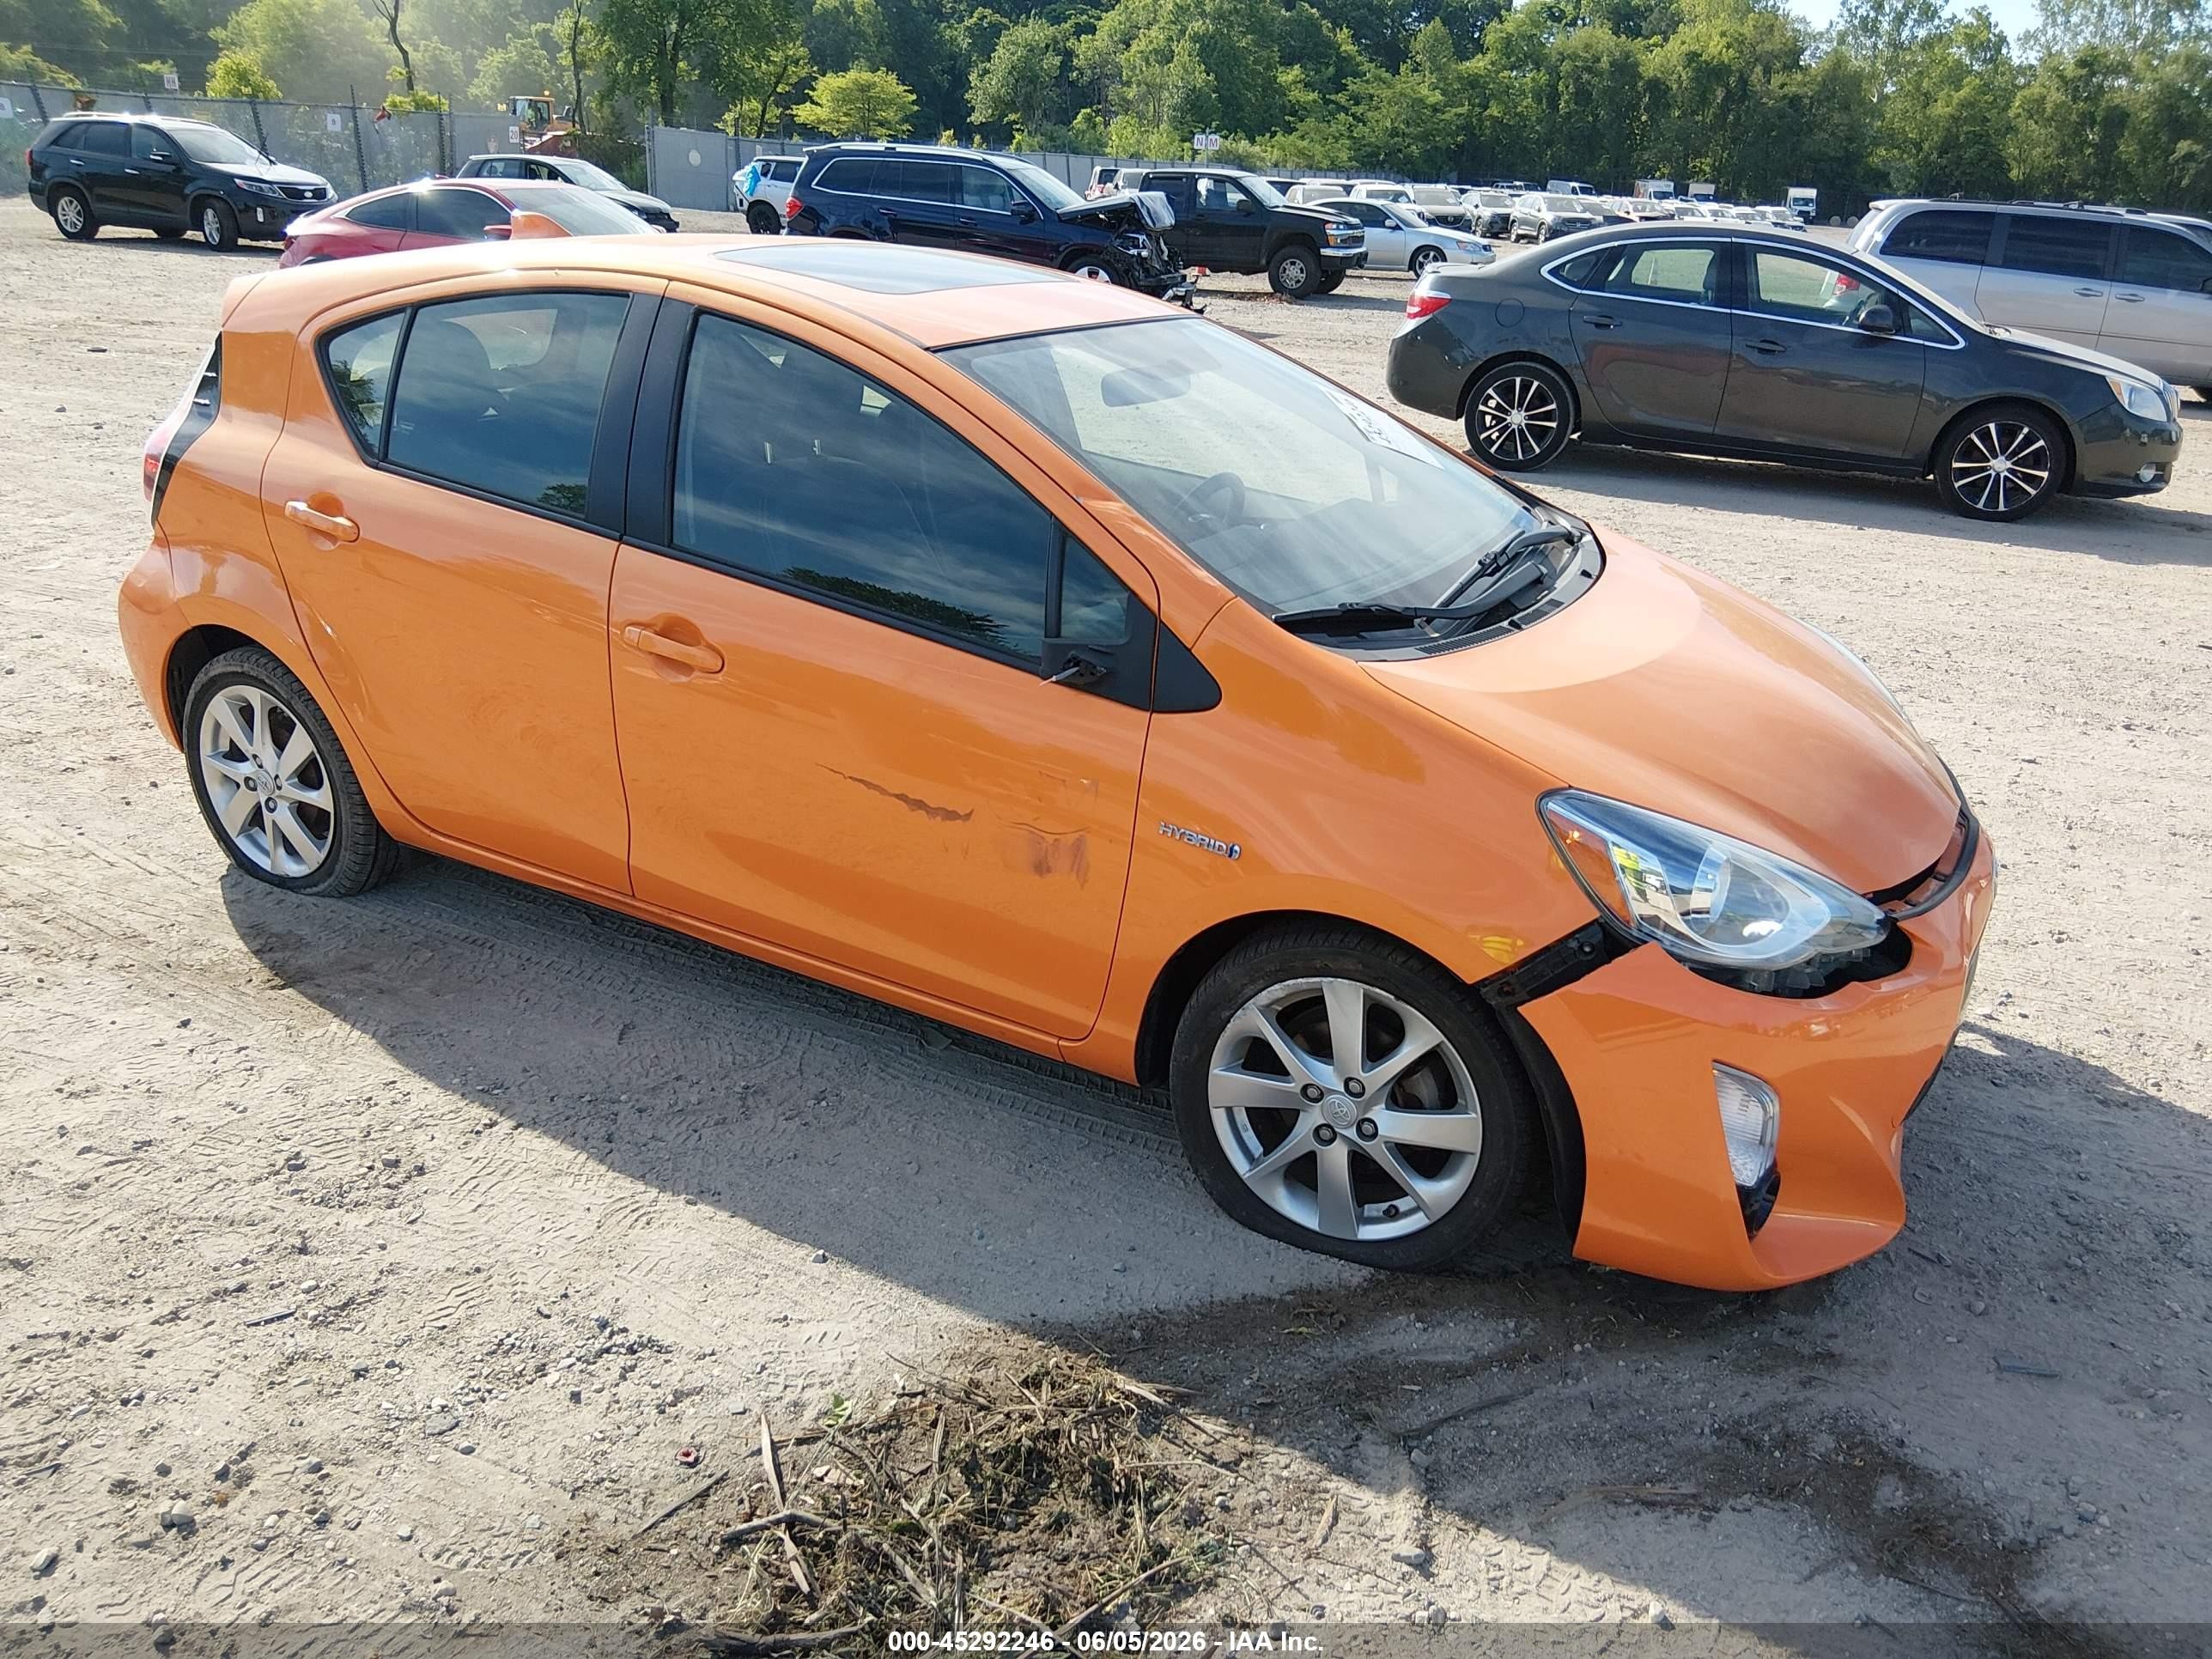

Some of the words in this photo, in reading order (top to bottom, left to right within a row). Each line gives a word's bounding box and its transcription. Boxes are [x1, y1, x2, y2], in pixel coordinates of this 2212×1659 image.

[510, 130, 519, 140] 20
[1196, 137, 1204, 145] N
[1209, 138, 1218, 148] M
[1158, 821, 1227, 856] HYBRID
